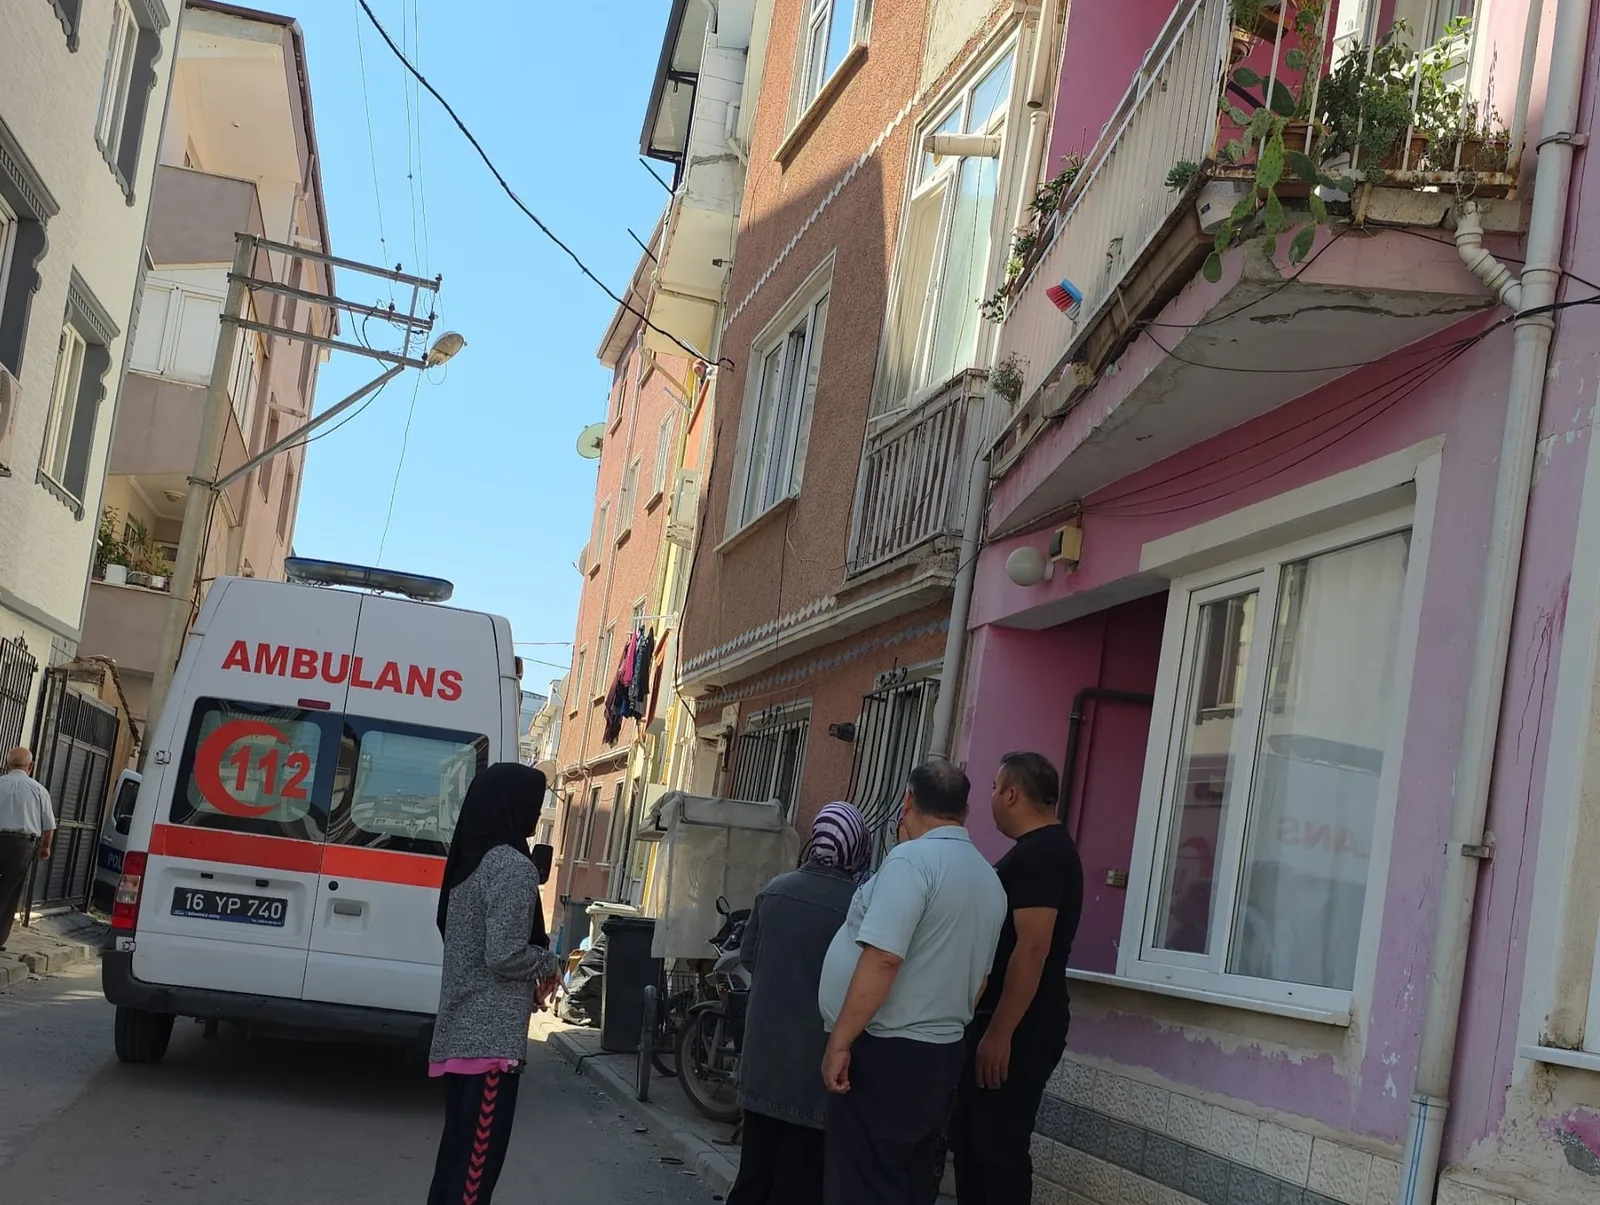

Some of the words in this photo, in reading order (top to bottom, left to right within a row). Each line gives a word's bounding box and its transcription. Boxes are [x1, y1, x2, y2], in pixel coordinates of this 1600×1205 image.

[221, 640, 463, 701] AMBULANS
[230, 745, 311, 799] 112
[185, 893, 204, 910] 16
[215, 895, 240, 914] YP
[247, 900, 282, 919] 740
